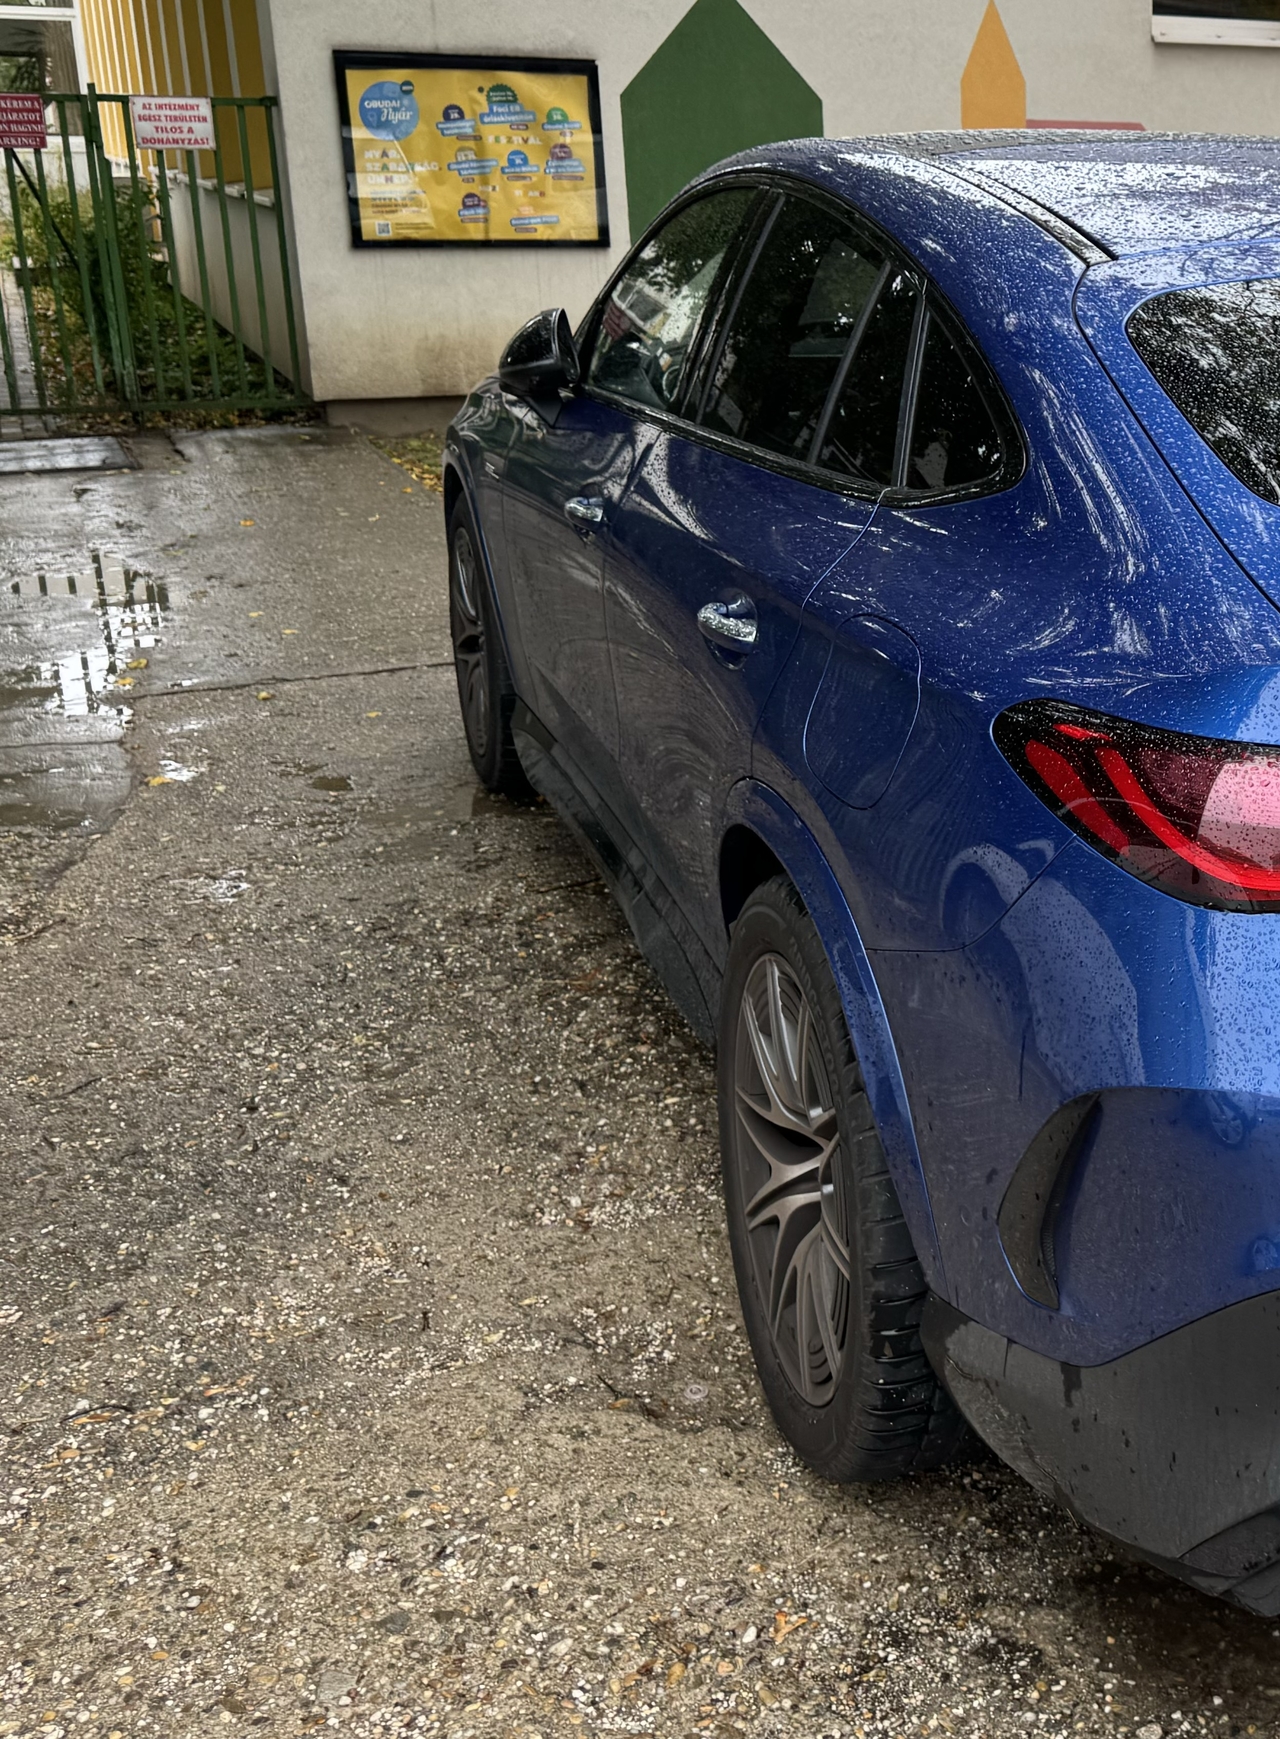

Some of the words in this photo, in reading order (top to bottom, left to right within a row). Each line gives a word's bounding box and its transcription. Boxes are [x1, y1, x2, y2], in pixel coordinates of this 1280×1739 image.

[33, 100, 40, 109] A
[142, 103, 152, 111] AZ
[154, 101, 200, 111] INTÉZMÉNY
[137, 113, 161, 122] EGÉSZ
[381, 107, 413, 124] Nyár
[154, 126, 184, 134] TILOS
[187, 126, 195, 134] A
[141, 136, 209, 145] DOHÁNYZÁS!
